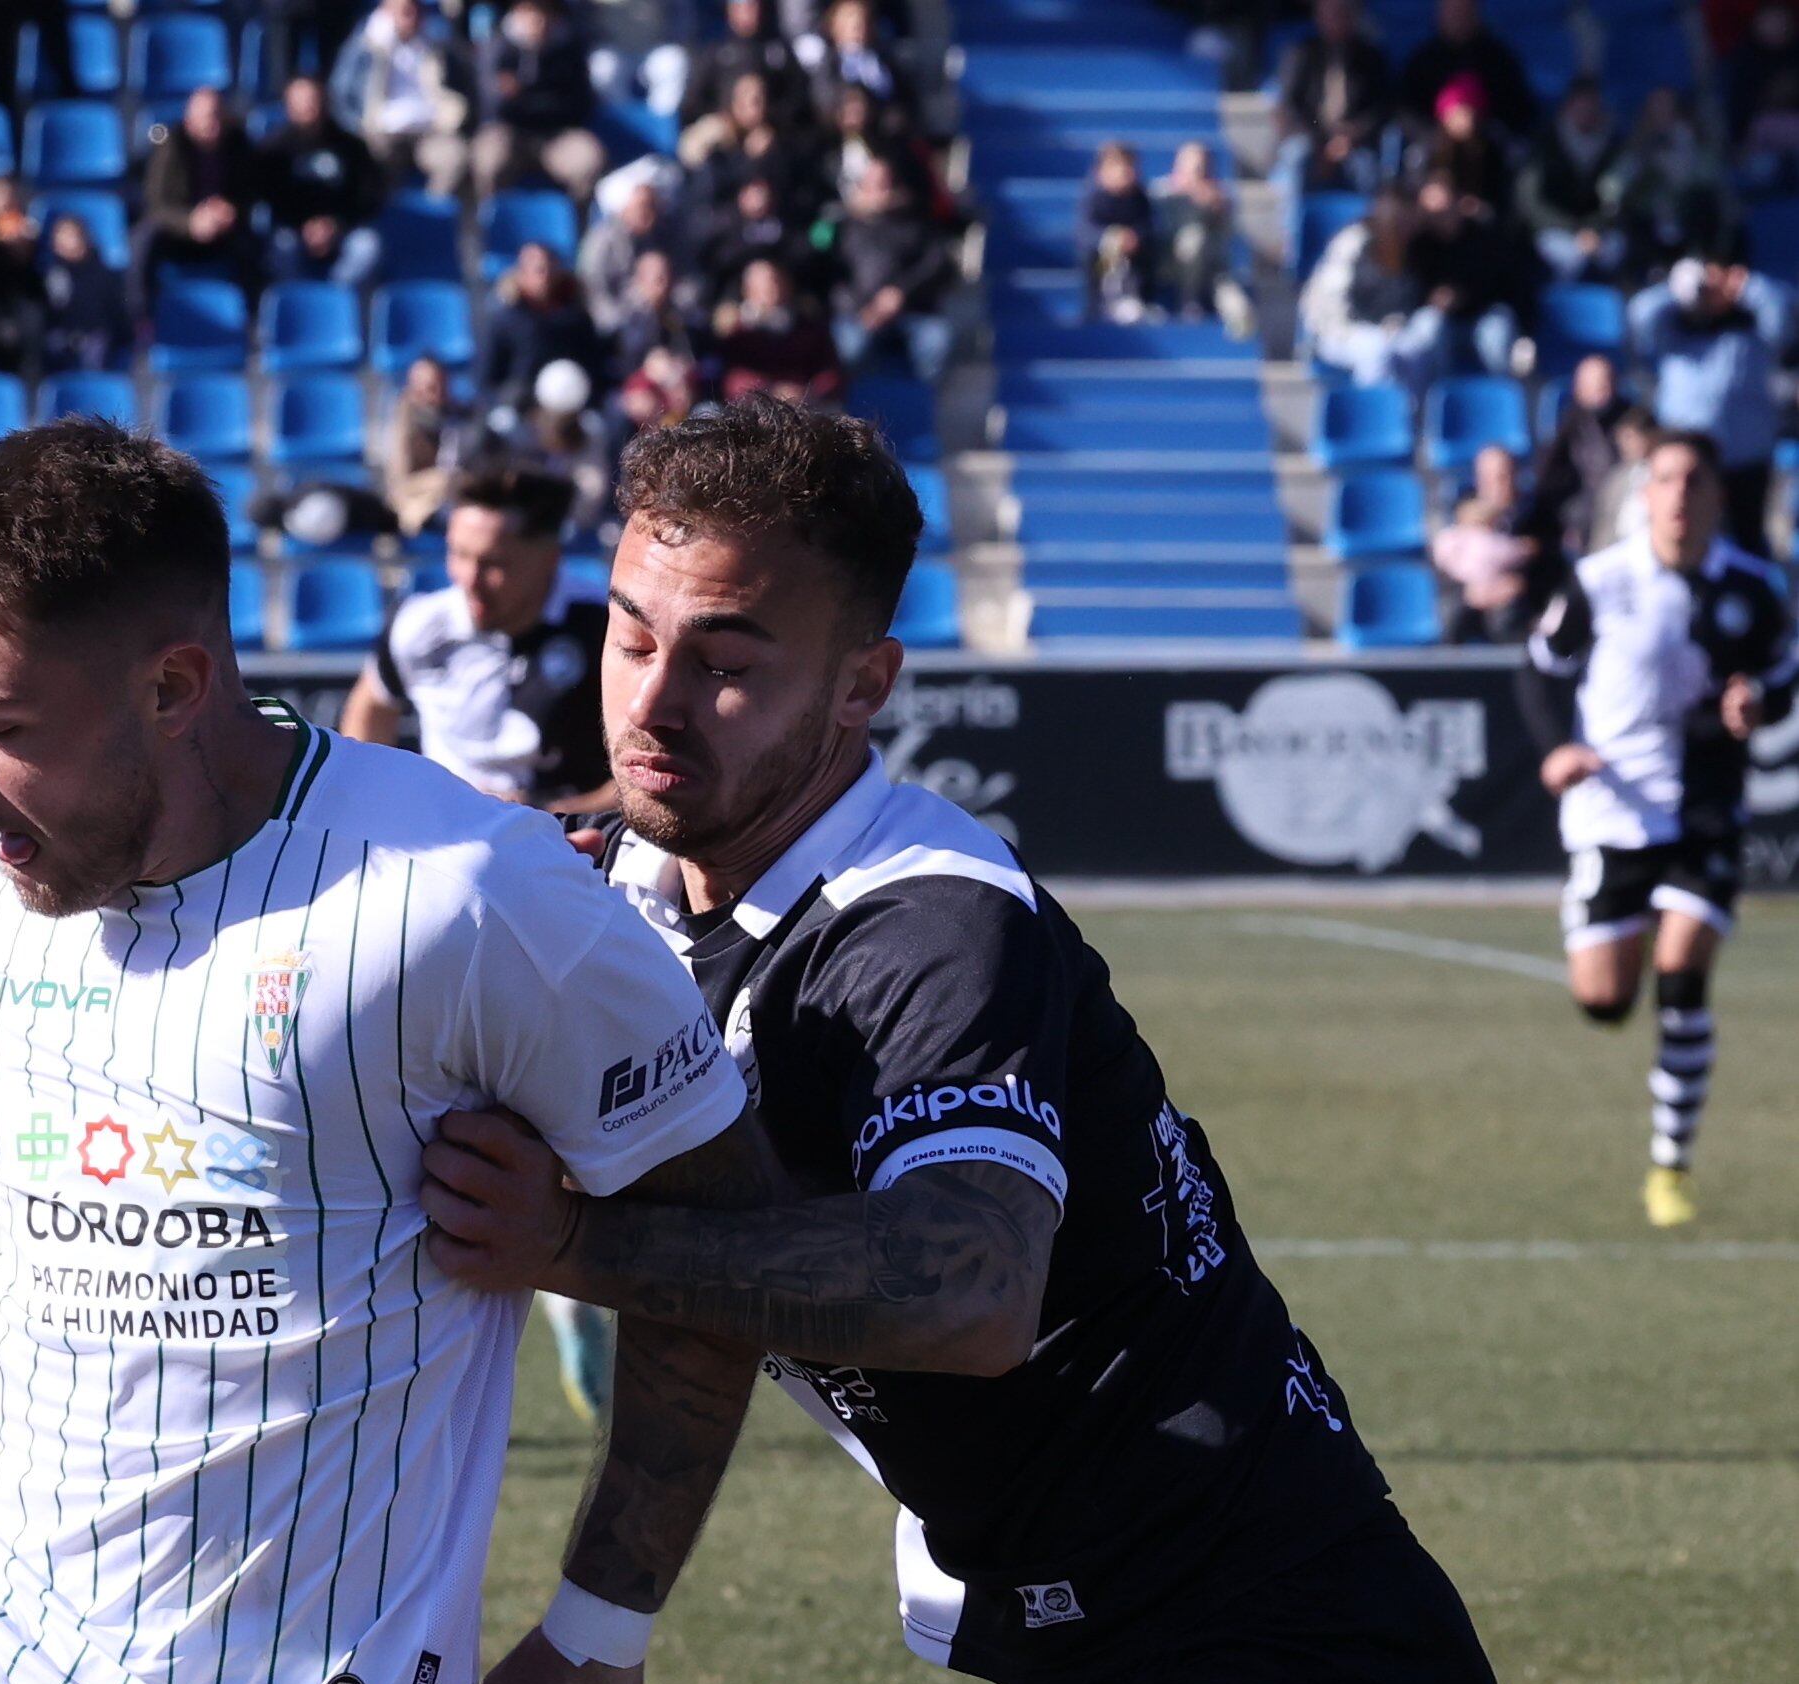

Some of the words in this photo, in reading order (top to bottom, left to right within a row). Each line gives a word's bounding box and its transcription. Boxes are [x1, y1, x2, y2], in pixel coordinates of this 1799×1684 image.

[670, 1081, 684, 1097] de
[684, 1044, 720, 1086] Seguros
[903, 1148, 945, 1168] HEMOS
[949, 1145, 997, 1157] NACIDO
[1000, 1151, 1037, 1172] JUNTOS
[25, 1192, 275, 1249] CÓRDOBA
[31, 1264, 218, 1302] PATRIMONIO
[230, 1268, 278, 1301] DE
[63, 1306, 280, 1340] HUMANIDAD
